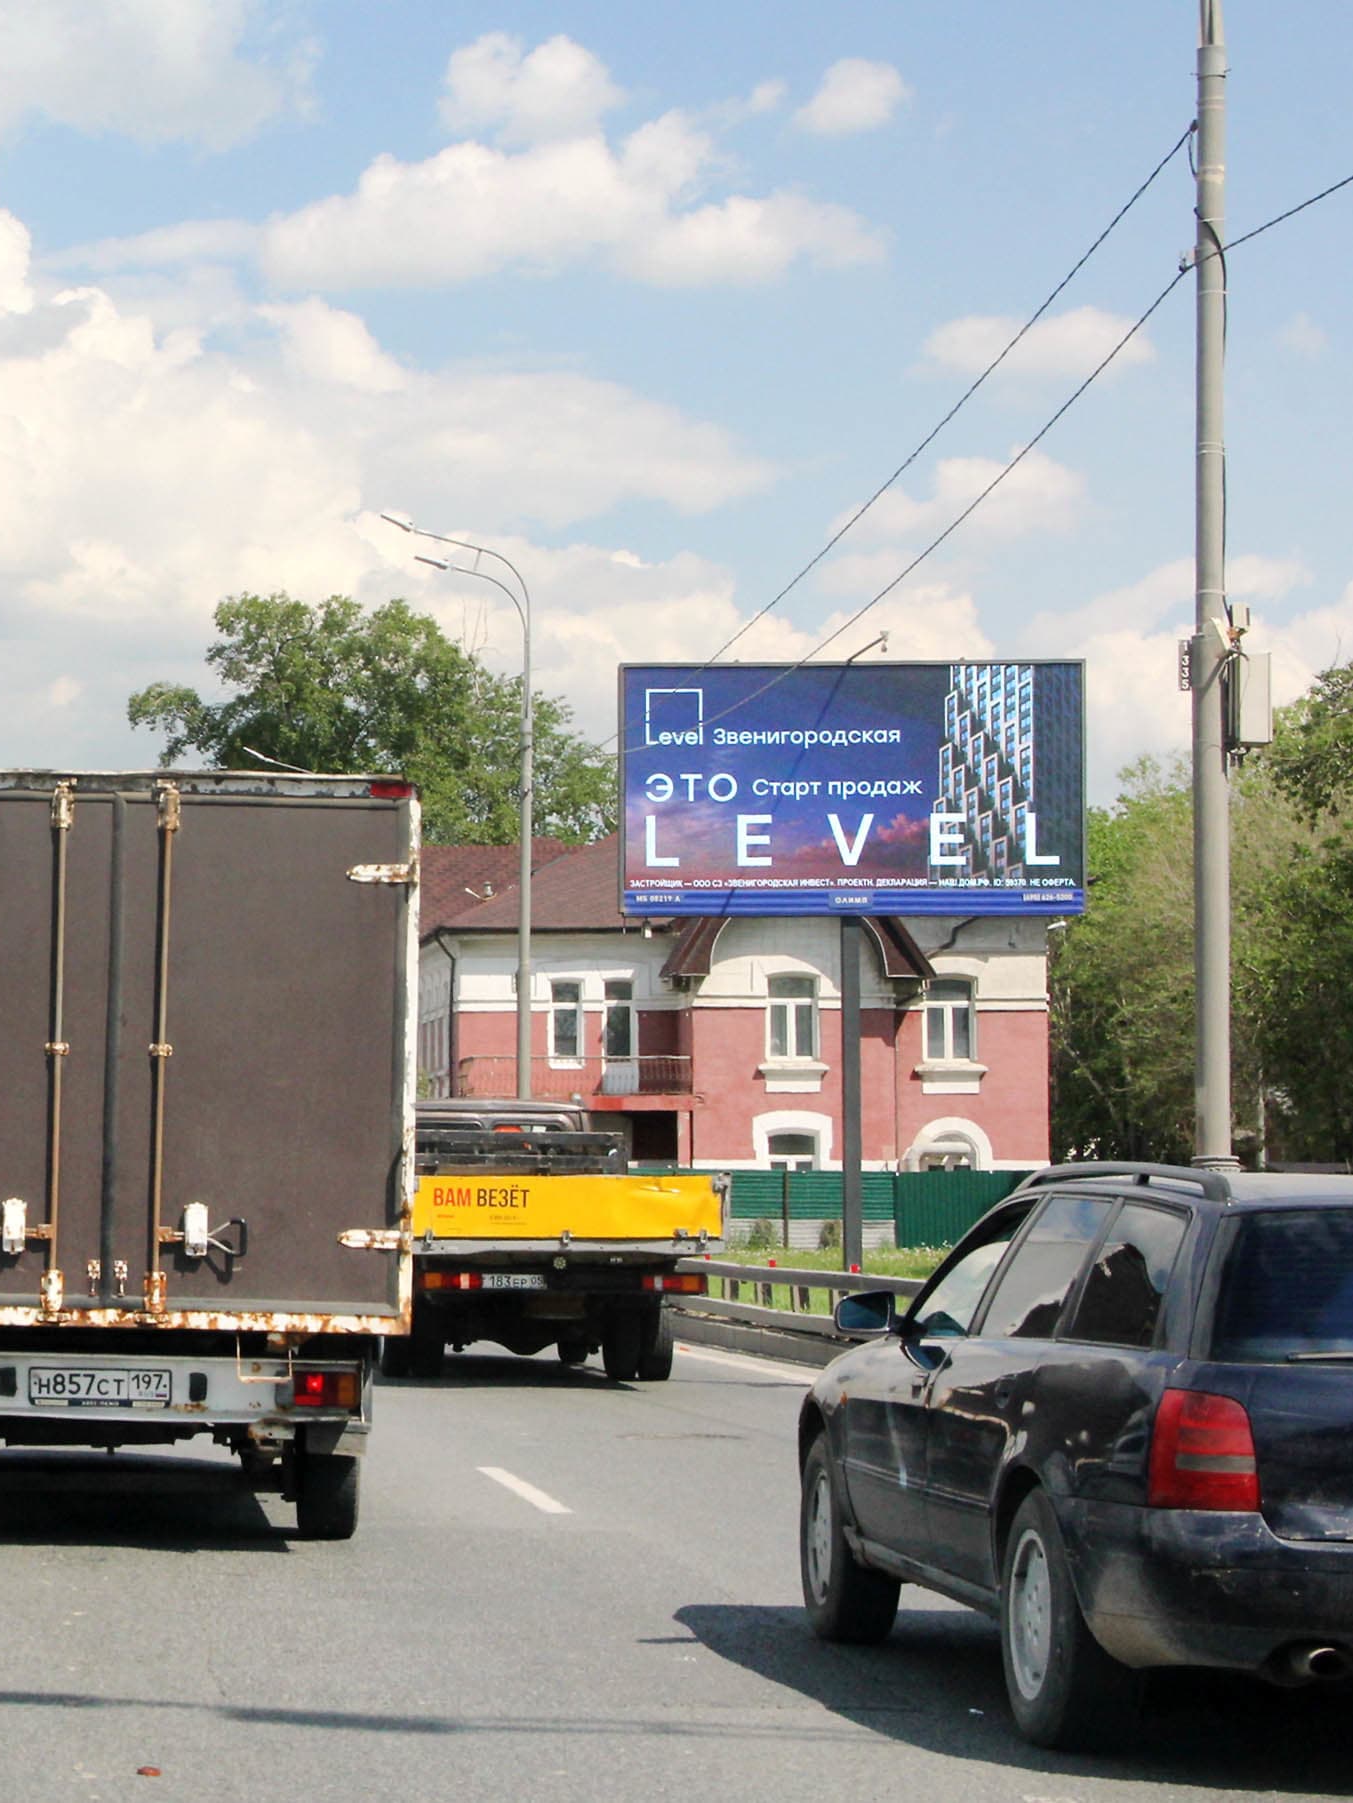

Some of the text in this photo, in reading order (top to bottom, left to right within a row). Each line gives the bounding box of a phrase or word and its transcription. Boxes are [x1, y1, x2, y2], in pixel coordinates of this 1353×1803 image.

[646, 723, 703, 745] Level
[713, 728, 901, 749] Звенигородская
[645, 773, 738, 803] ЭТО
[752, 778, 923, 801] Старт продаж
[645, 812, 1060, 868] LEVEL
[630, 879, 683, 888] ЗАСТРОЙЩИК
[693, 879, 711, 888] ООО
[876, 878, 928, 887] ДЕКЛАРАЦИЯ
[1029, 878, 1041, 887] НЕ
[433, 1184, 530, 1208] ВАМ ВЕЗЁТ
[38, 1373, 164, 1396] Н857СТ 197
